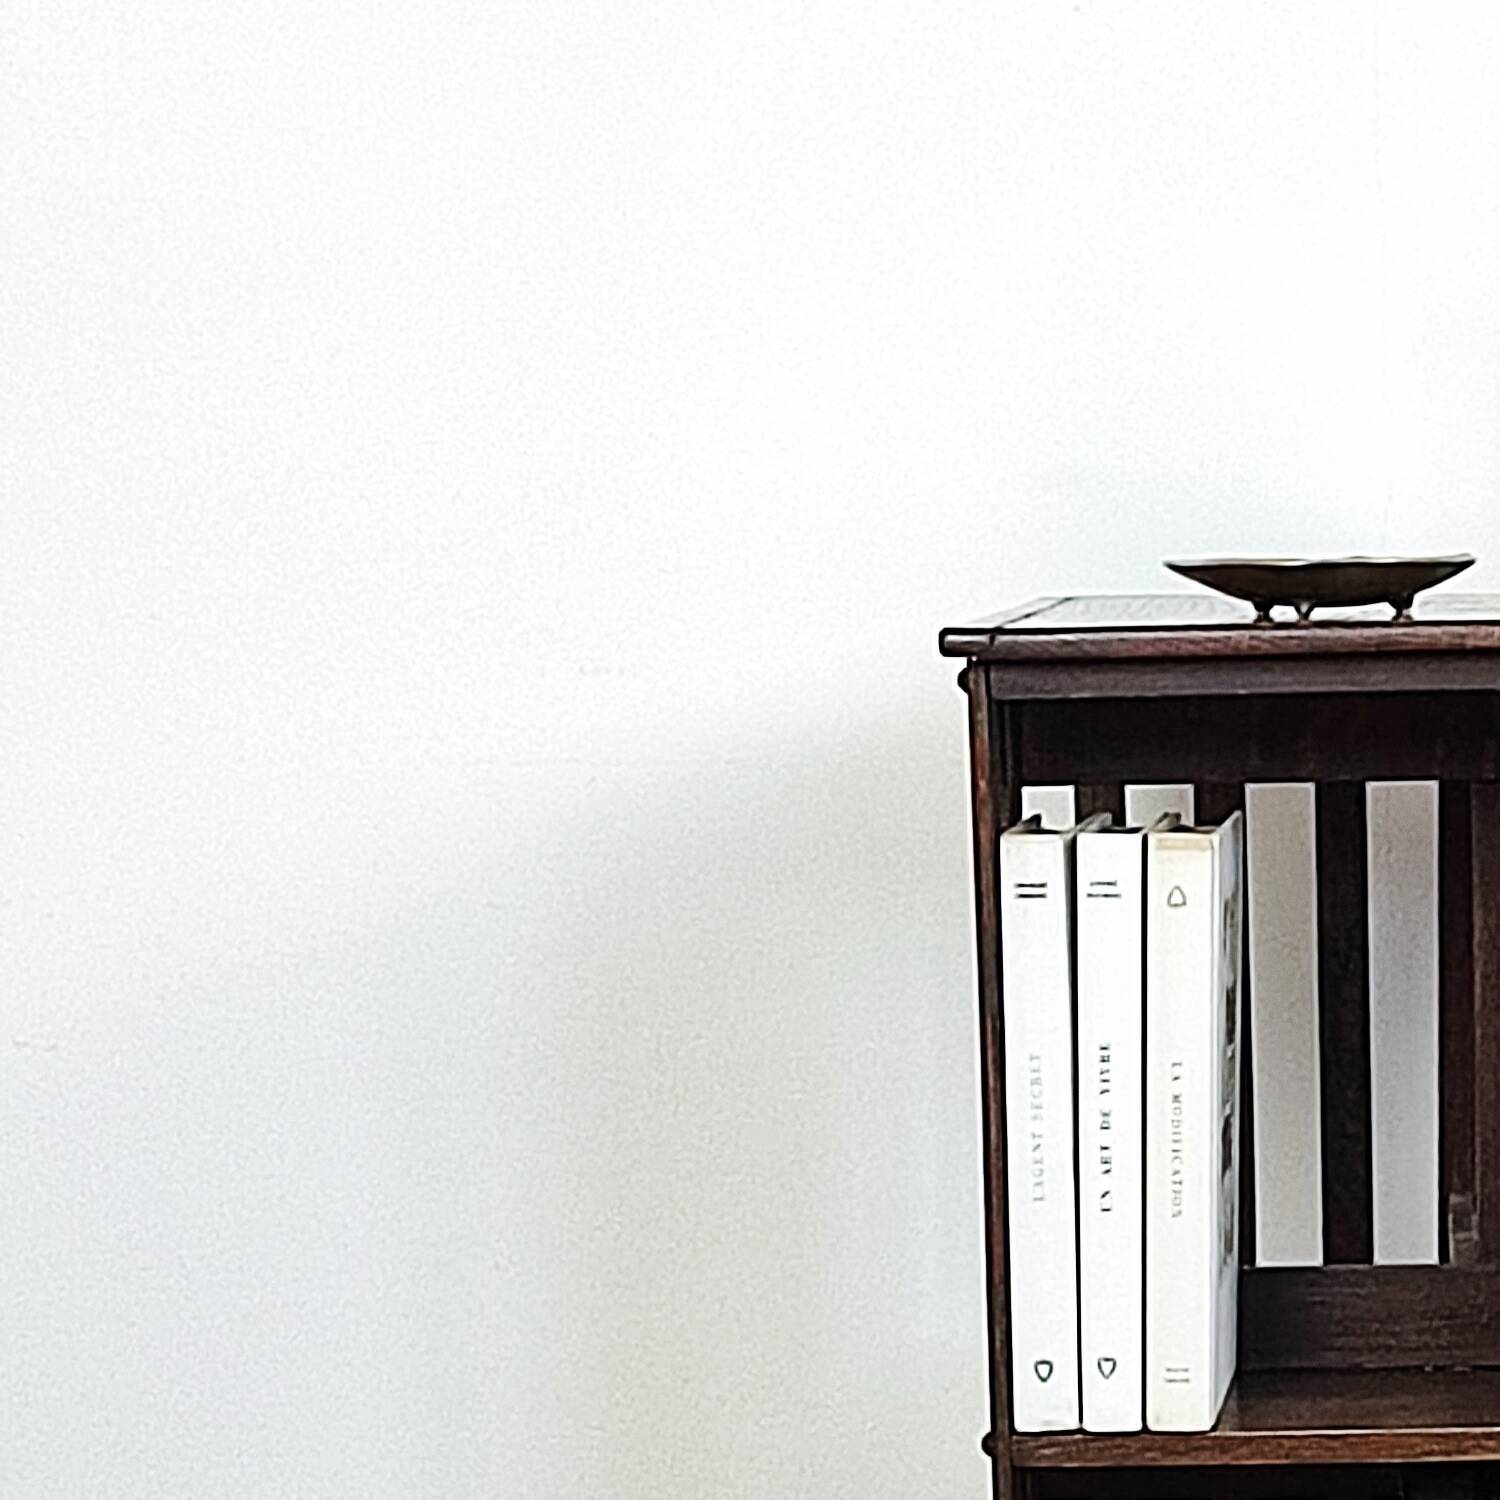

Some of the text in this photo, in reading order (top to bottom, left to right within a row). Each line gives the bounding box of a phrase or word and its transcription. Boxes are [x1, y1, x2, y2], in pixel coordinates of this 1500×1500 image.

[1029, 1052, 1044, 1122] SECRET
[1098, 1042, 1111, 1096] VIVRE
[1099, 1109, 1112, 1131] DE
[1170, 1061, 1184, 1220] LA MODIFICATION
[1100, 1143, 1112, 1176] ART
